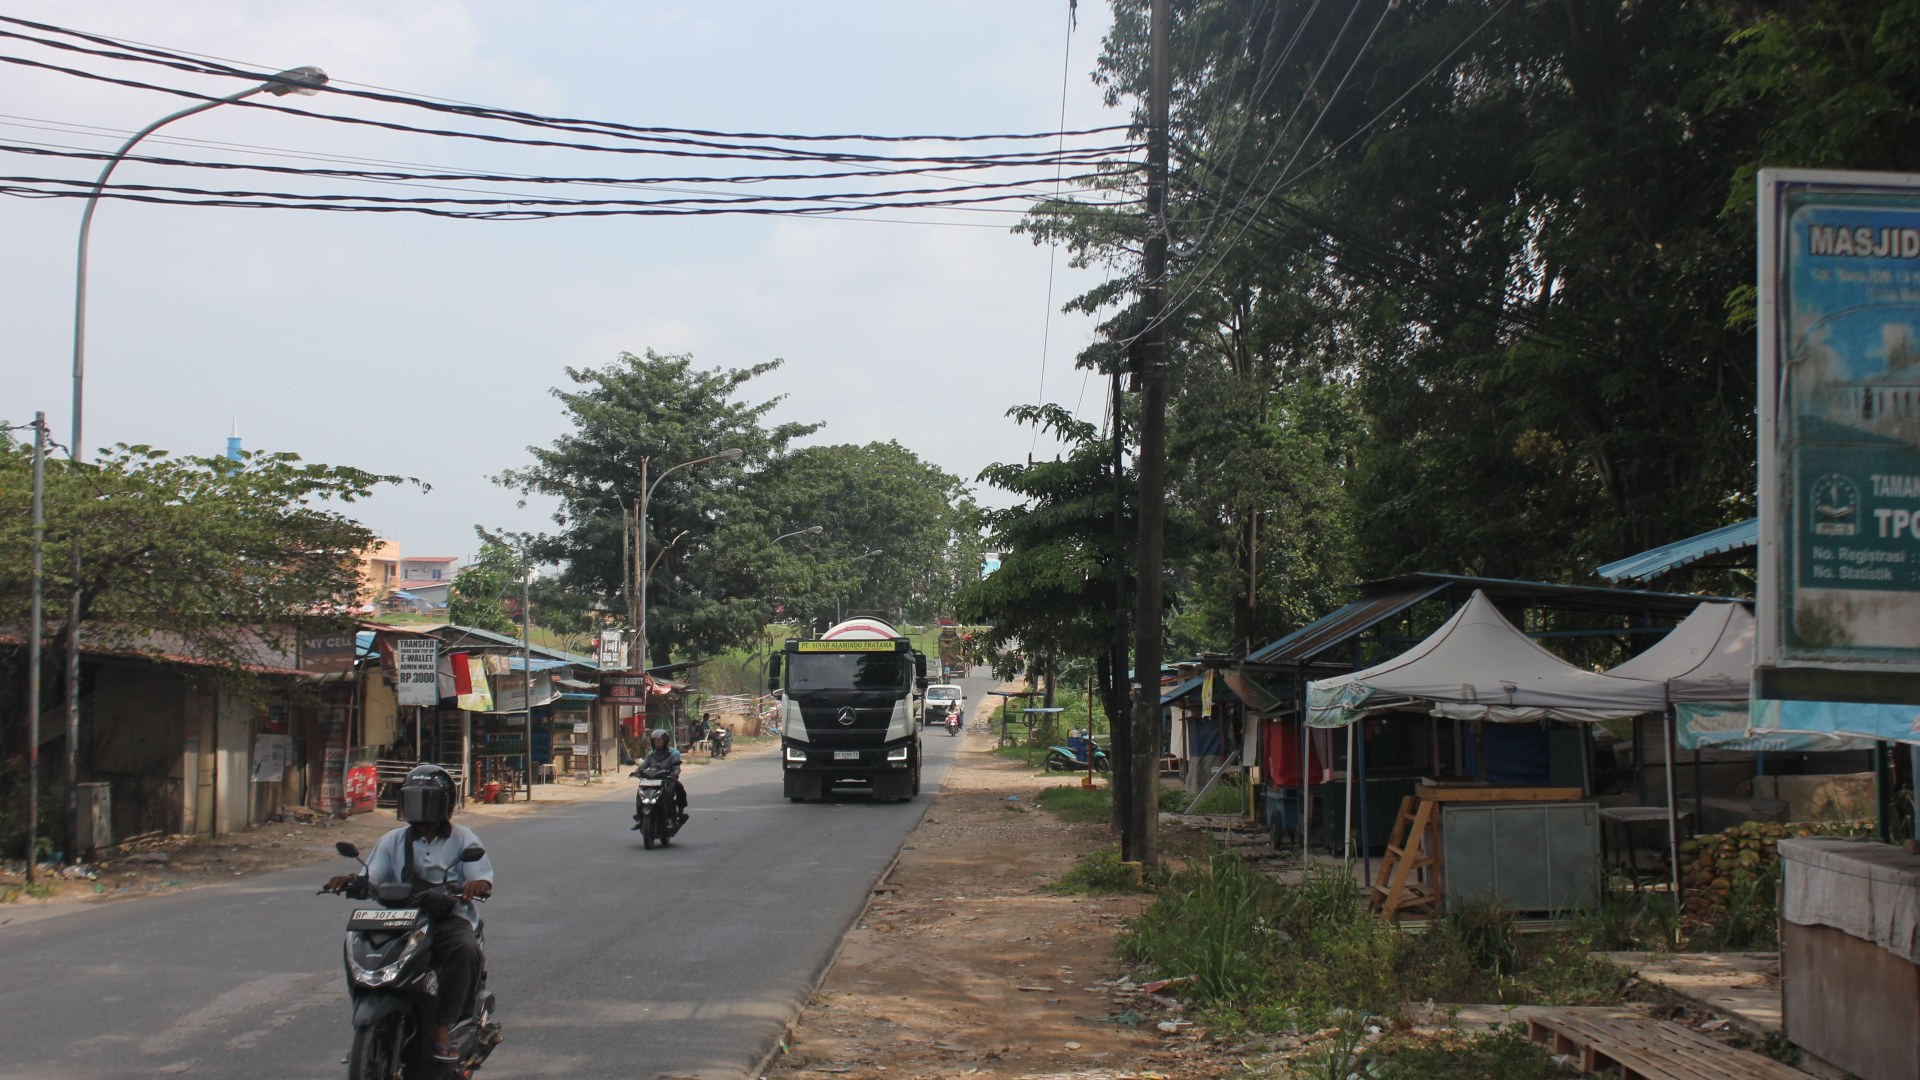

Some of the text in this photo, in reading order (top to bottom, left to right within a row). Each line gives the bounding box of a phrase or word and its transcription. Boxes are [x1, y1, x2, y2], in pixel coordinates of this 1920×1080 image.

[1810, 226, 1920, 258] MASJID
[1813, 547, 1835, 560] No.
[1838, 548, 1906, 564] Registrasi
[1813, 565, 1836, 578] No.
[1838, 566, 1893, 580] Statistik
[400, 640, 434, 648] TRANSFER
[401, 654, 433, 662] E-WALLET
[400, 672, 434, 683] RP.3000
[355, 911, 368, 919] BP
[403, 911, 416, 919] PU
